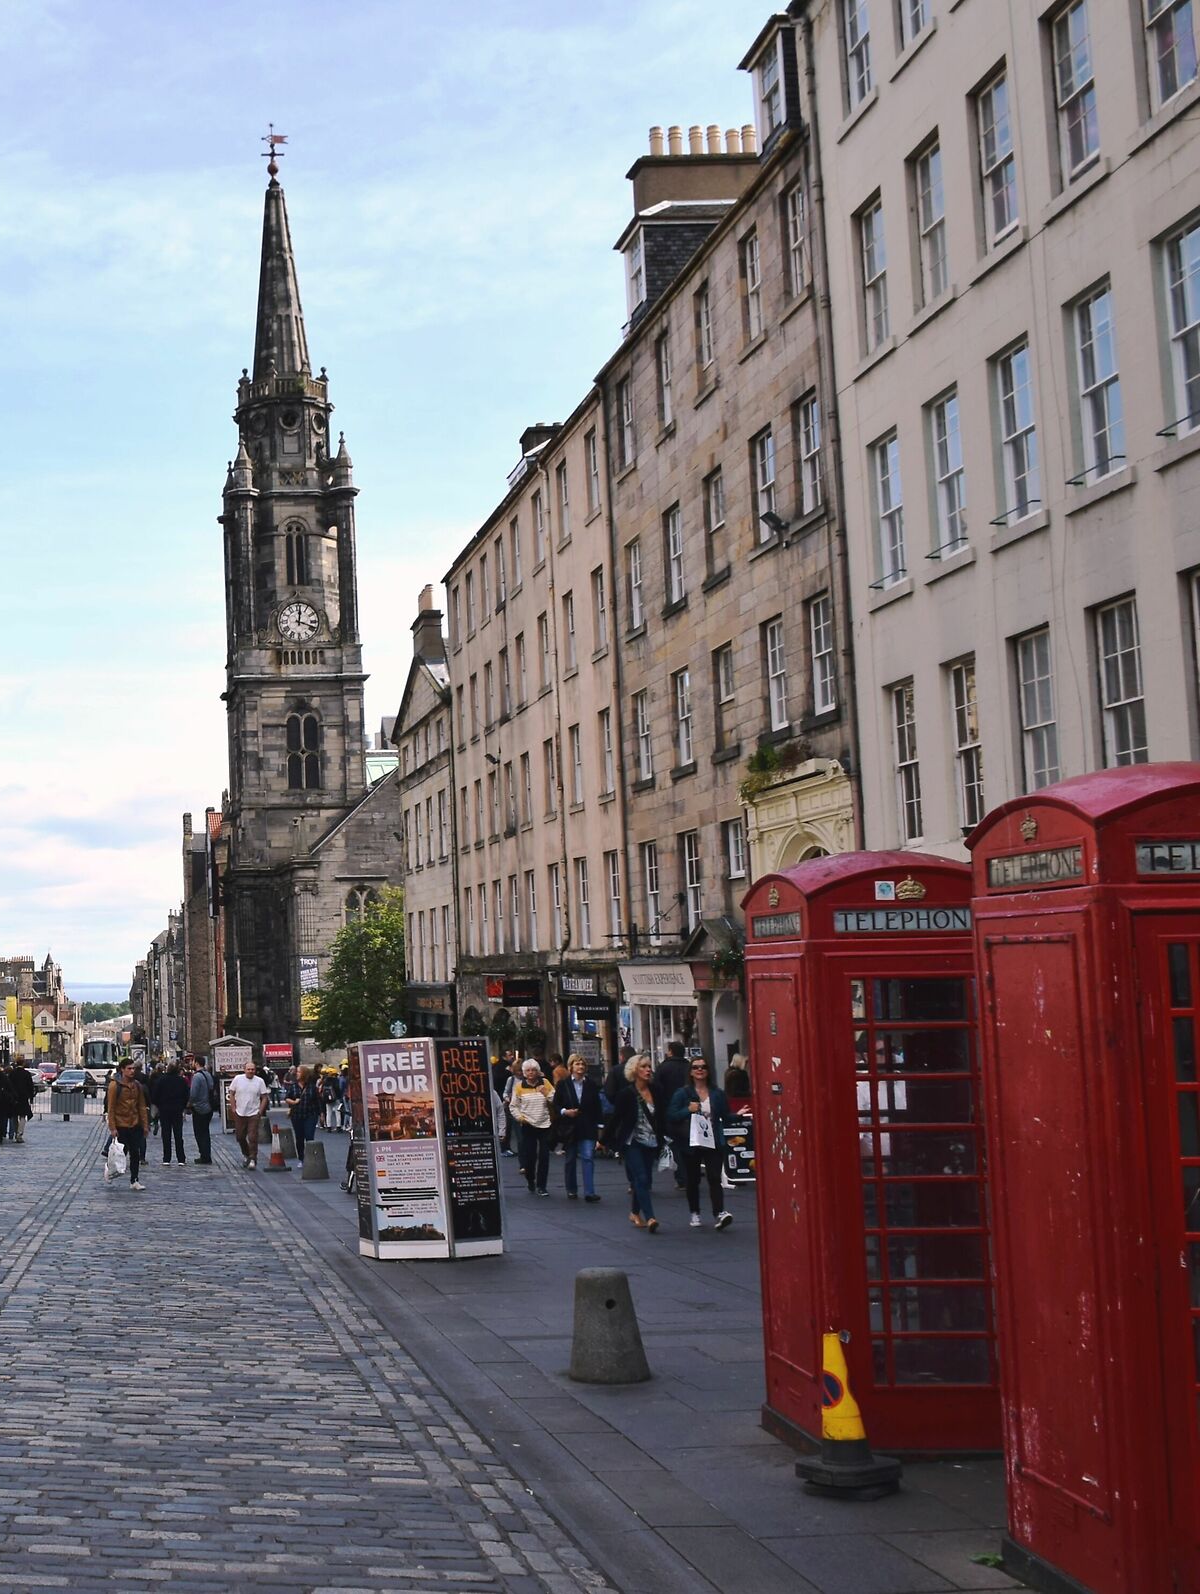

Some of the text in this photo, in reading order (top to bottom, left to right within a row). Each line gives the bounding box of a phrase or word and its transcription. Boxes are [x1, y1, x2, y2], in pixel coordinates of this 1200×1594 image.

[991, 848, 1081, 885] TELEPHONE
[562, 976, 593, 991] WARHAMMER
[632, 973, 685, 985] SCOTTISH EXPERIENCE
[367, 1051, 426, 1073] FREE
[441, 1048, 480, 1073] FREE
[367, 1075, 429, 1095] TOUR
[440, 1072, 487, 1095] GHOST
[443, 1097, 490, 1120] TOUR
